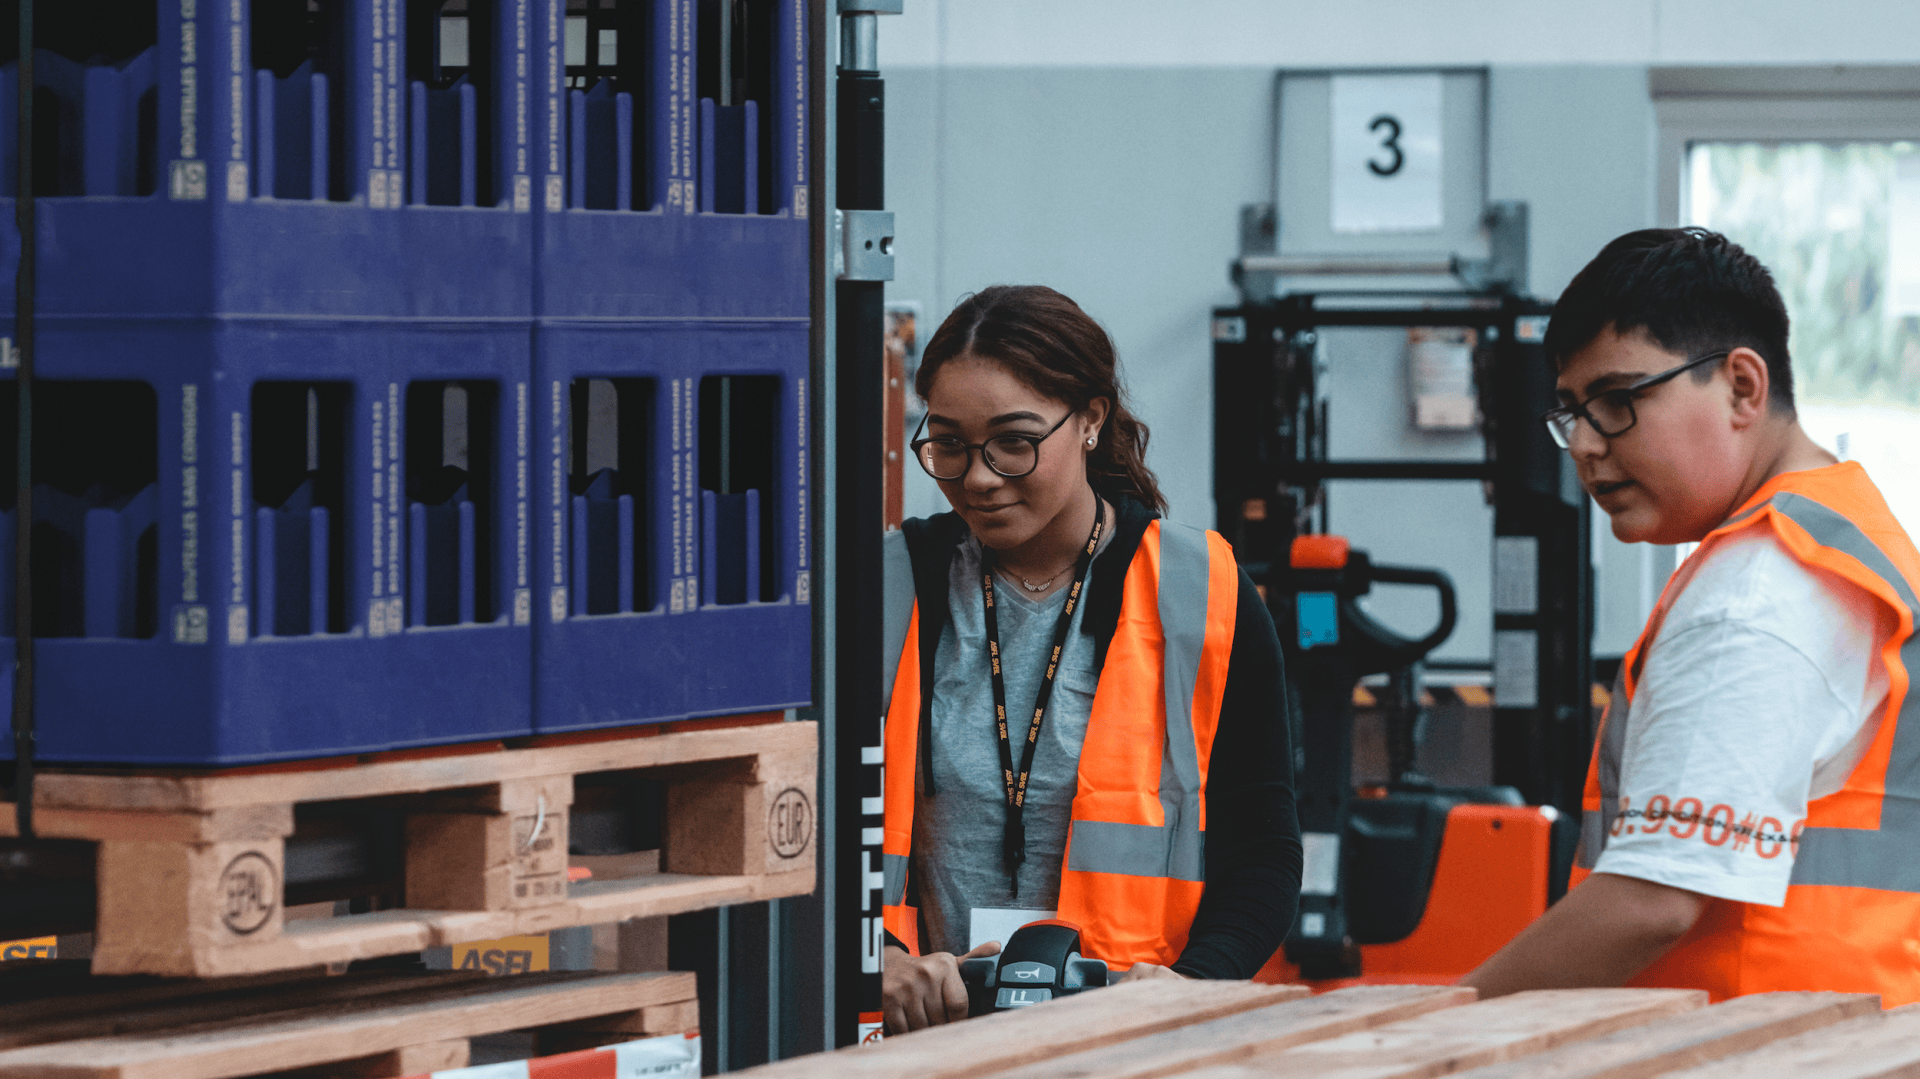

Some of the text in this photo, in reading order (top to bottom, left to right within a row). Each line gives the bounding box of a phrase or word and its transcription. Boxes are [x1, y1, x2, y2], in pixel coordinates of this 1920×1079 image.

[795, 64, 804, 100] SANS
[795, 103, 804, 182] BOUTEILLES
[1366, 114, 1404, 176] 3
[798, 378, 806, 447] CONSIGNE
[672, 454, 681, 491] SANS
[798, 450, 806, 486] SANS
[798, 489, 807, 567] BOUTEILLES
[1065, 598, 1076, 616] ASFL
[990, 640, 999, 657] ASFL
[1046, 664, 1056, 681] ASFL
[997, 704, 1006, 722] ASFL
[1028, 726, 1039, 744] ASFL
[777, 801, 804, 846] EUR
[861, 716, 885, 973] STILL
